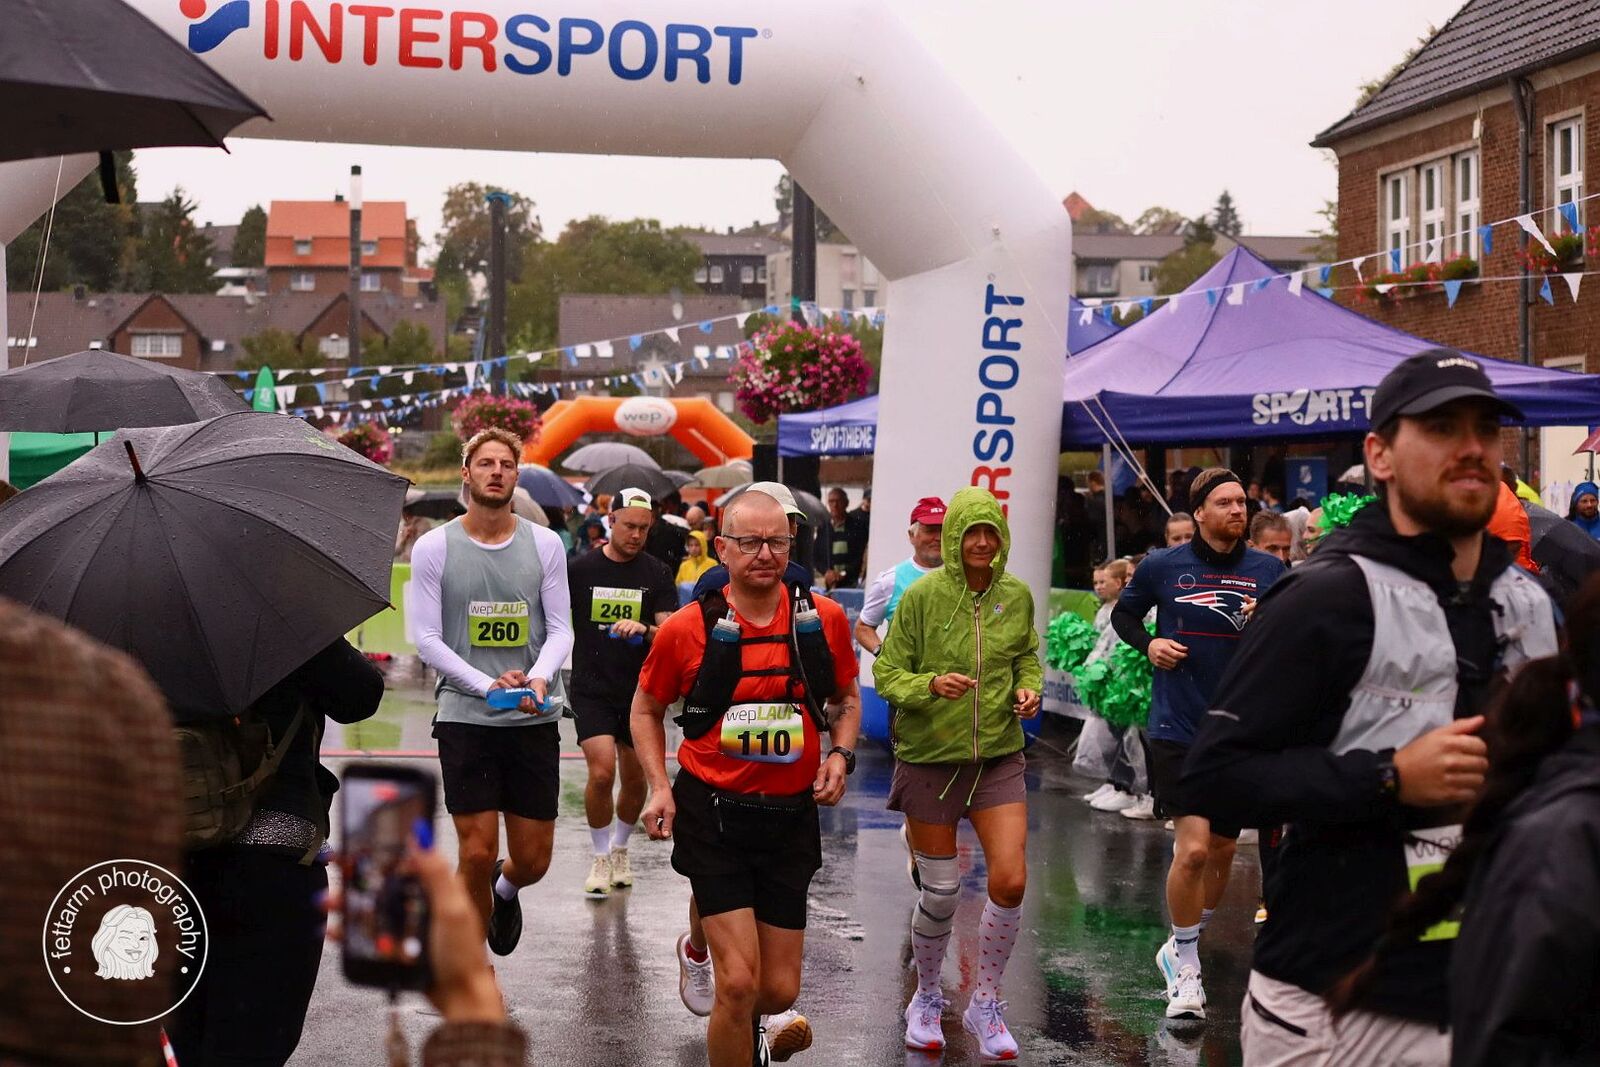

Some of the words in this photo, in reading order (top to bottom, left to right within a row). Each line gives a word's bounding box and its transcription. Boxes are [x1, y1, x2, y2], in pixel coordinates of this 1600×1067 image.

[264, 0, 758, 85] INTERSPORT
[970, 283, 1025, 521] RSPORT
[624, 412, 662, 423] wep
[810, 424, 872, 452] SPORT-THIEME
[1221, 579, 1257, 588] PATRIOTS
[595, 588, 640, 601] wepLAUF
[471, 603, 528, 615] wepLAUF
[601, 603, 632, 619] 248
[478, 621, 520, 642] 260
[737, 730, 791, 757] 110
